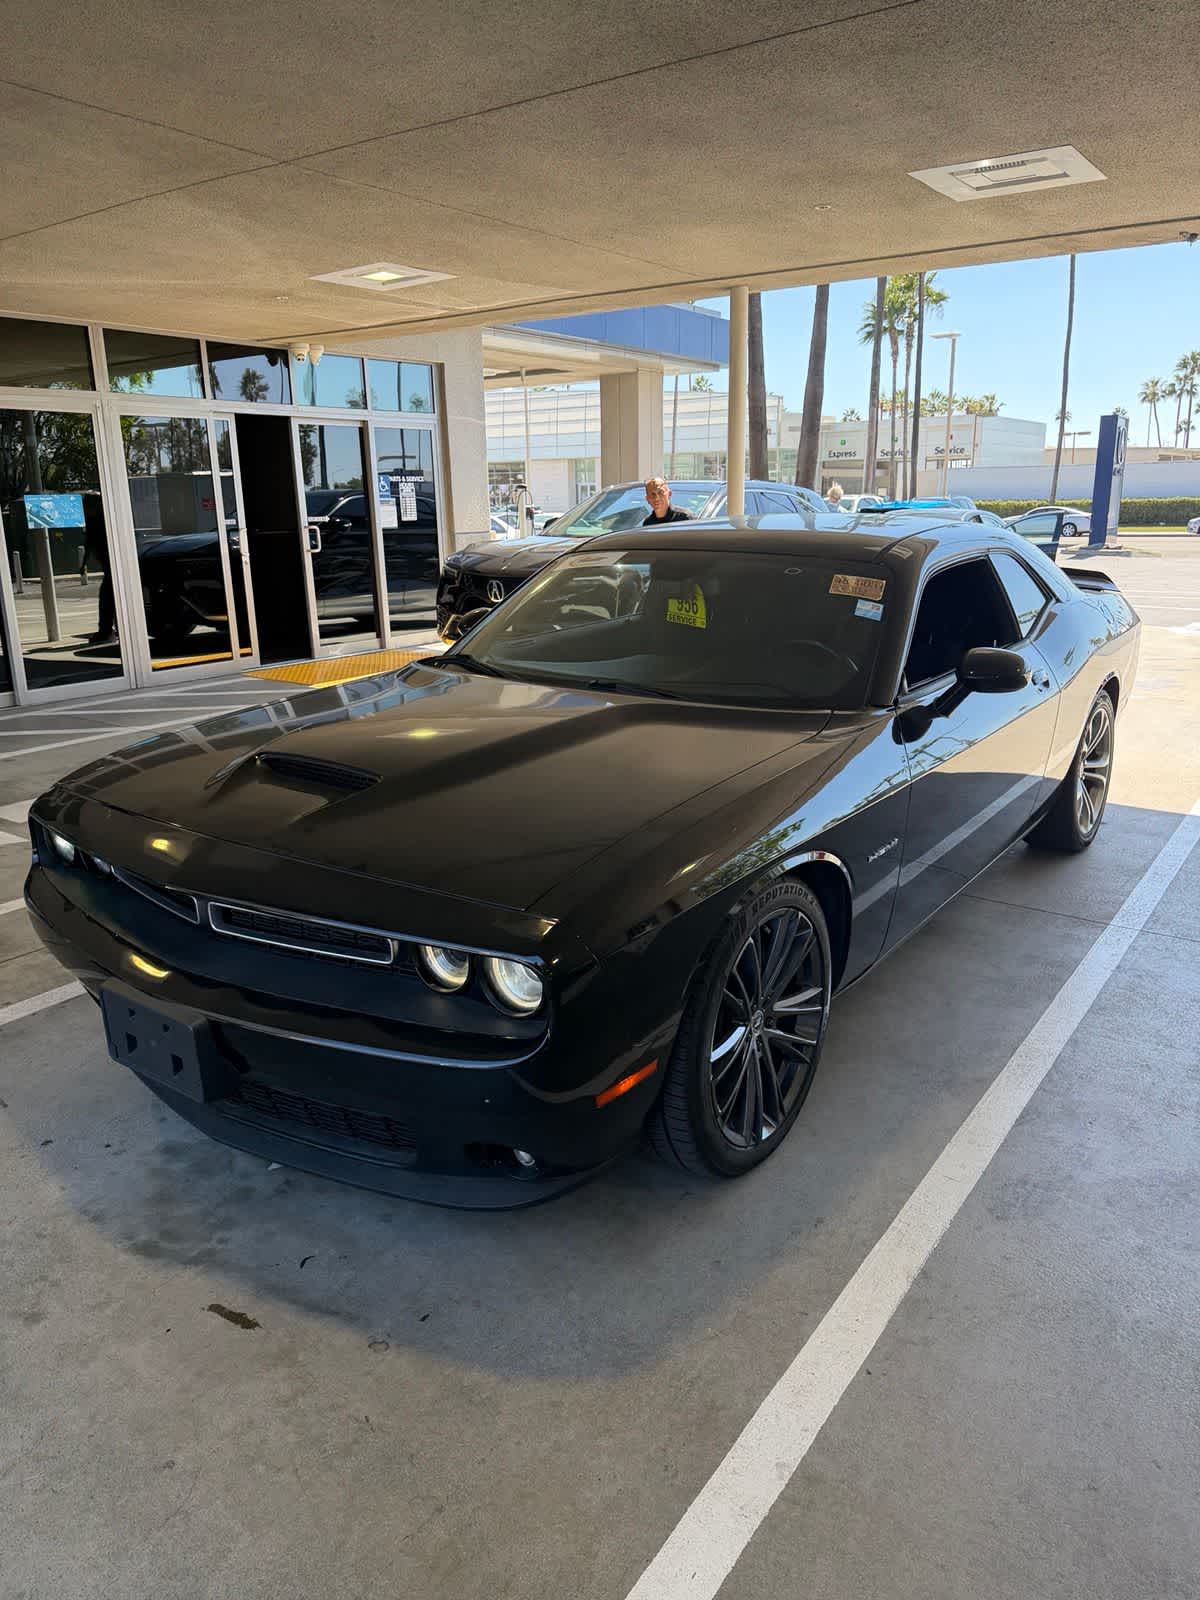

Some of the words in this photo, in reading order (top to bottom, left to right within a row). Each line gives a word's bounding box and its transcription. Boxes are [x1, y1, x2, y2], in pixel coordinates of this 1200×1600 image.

[828, 449, 857, 458] Express
[880, 448, 909, 457] Sevic
[934, 445, 965, 455] Sevice
[668, 613, 697, 626] SERVICE
